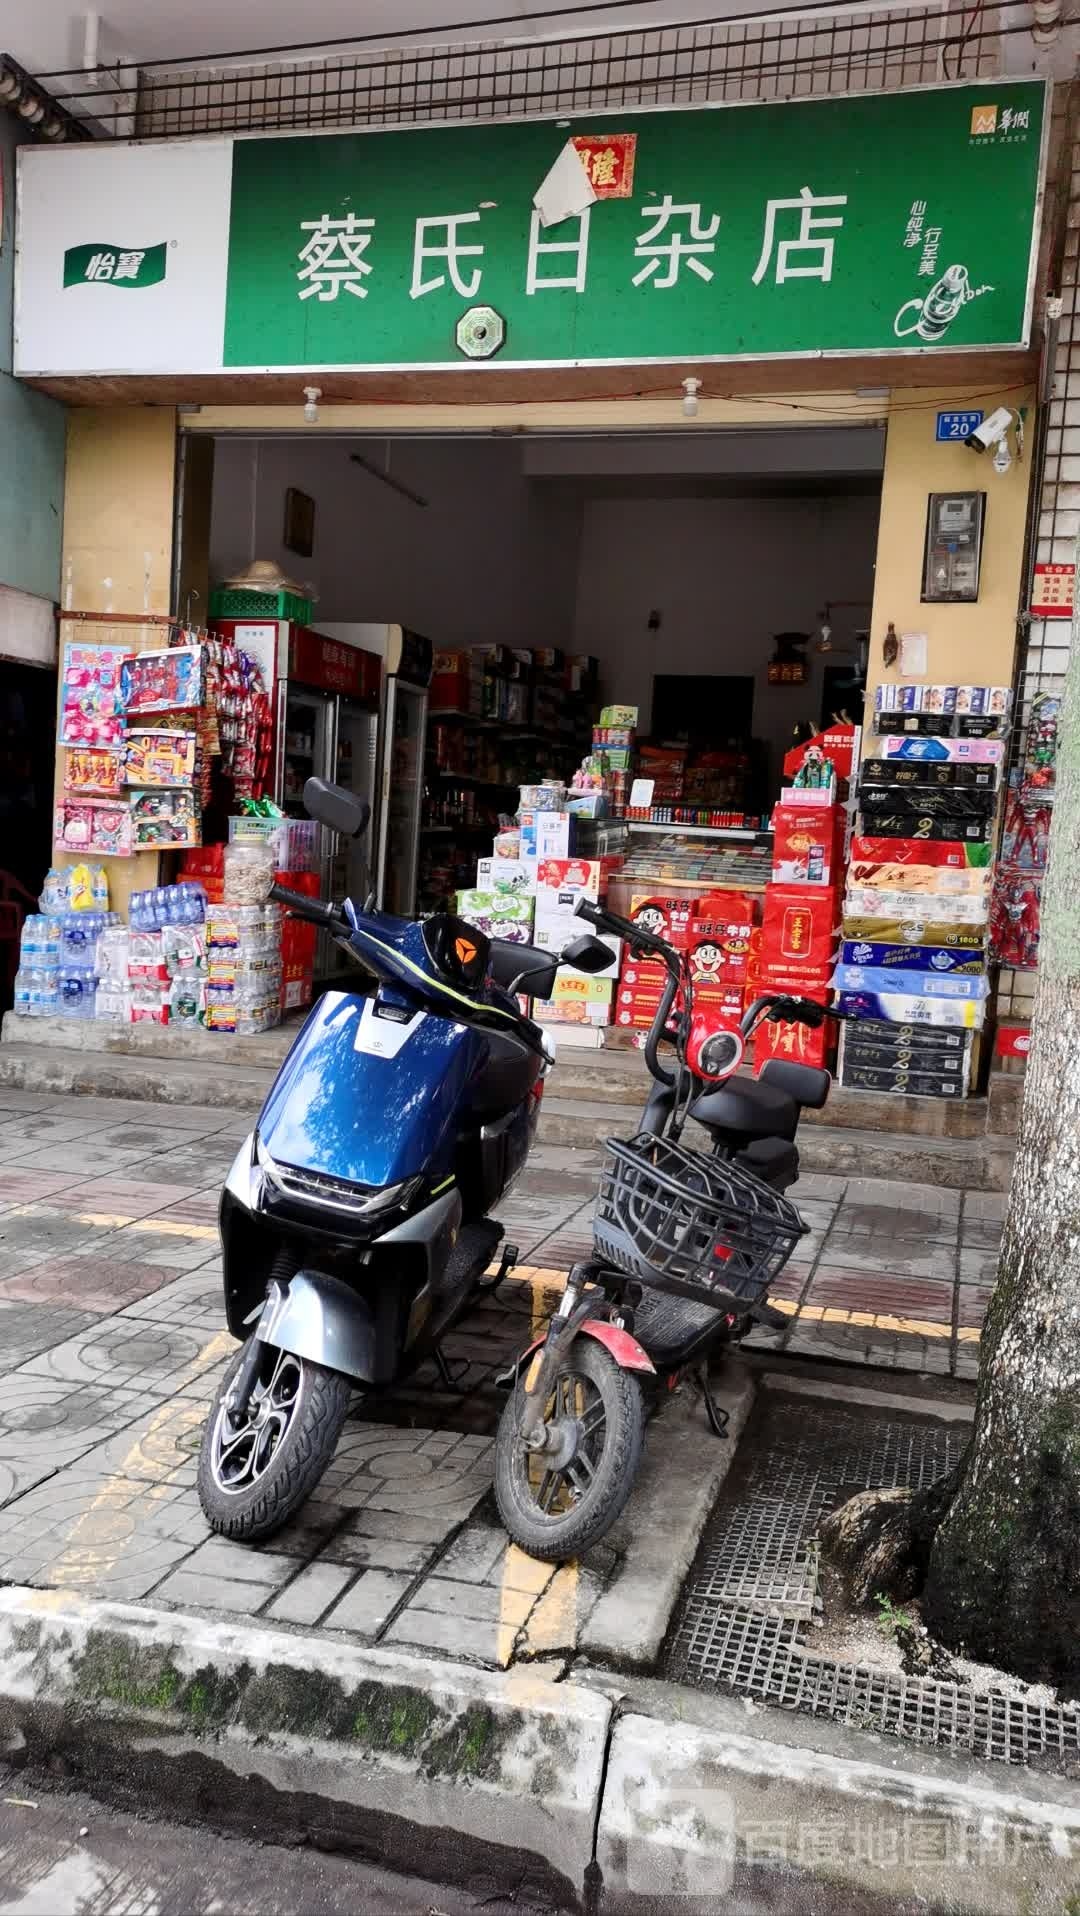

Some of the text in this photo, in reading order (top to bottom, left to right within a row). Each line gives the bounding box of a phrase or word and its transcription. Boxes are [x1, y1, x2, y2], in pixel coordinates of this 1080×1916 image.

[904, 200, 927, 248] 心纯净
[297, 186, 848, 303] 蔡氏日杂店
[918, 227, 942, 276] 行至美
[950, 423, 969, 436] 20
[892, 1049, 912, 1070] 2
[889, 1073, 909, 1093] 2
